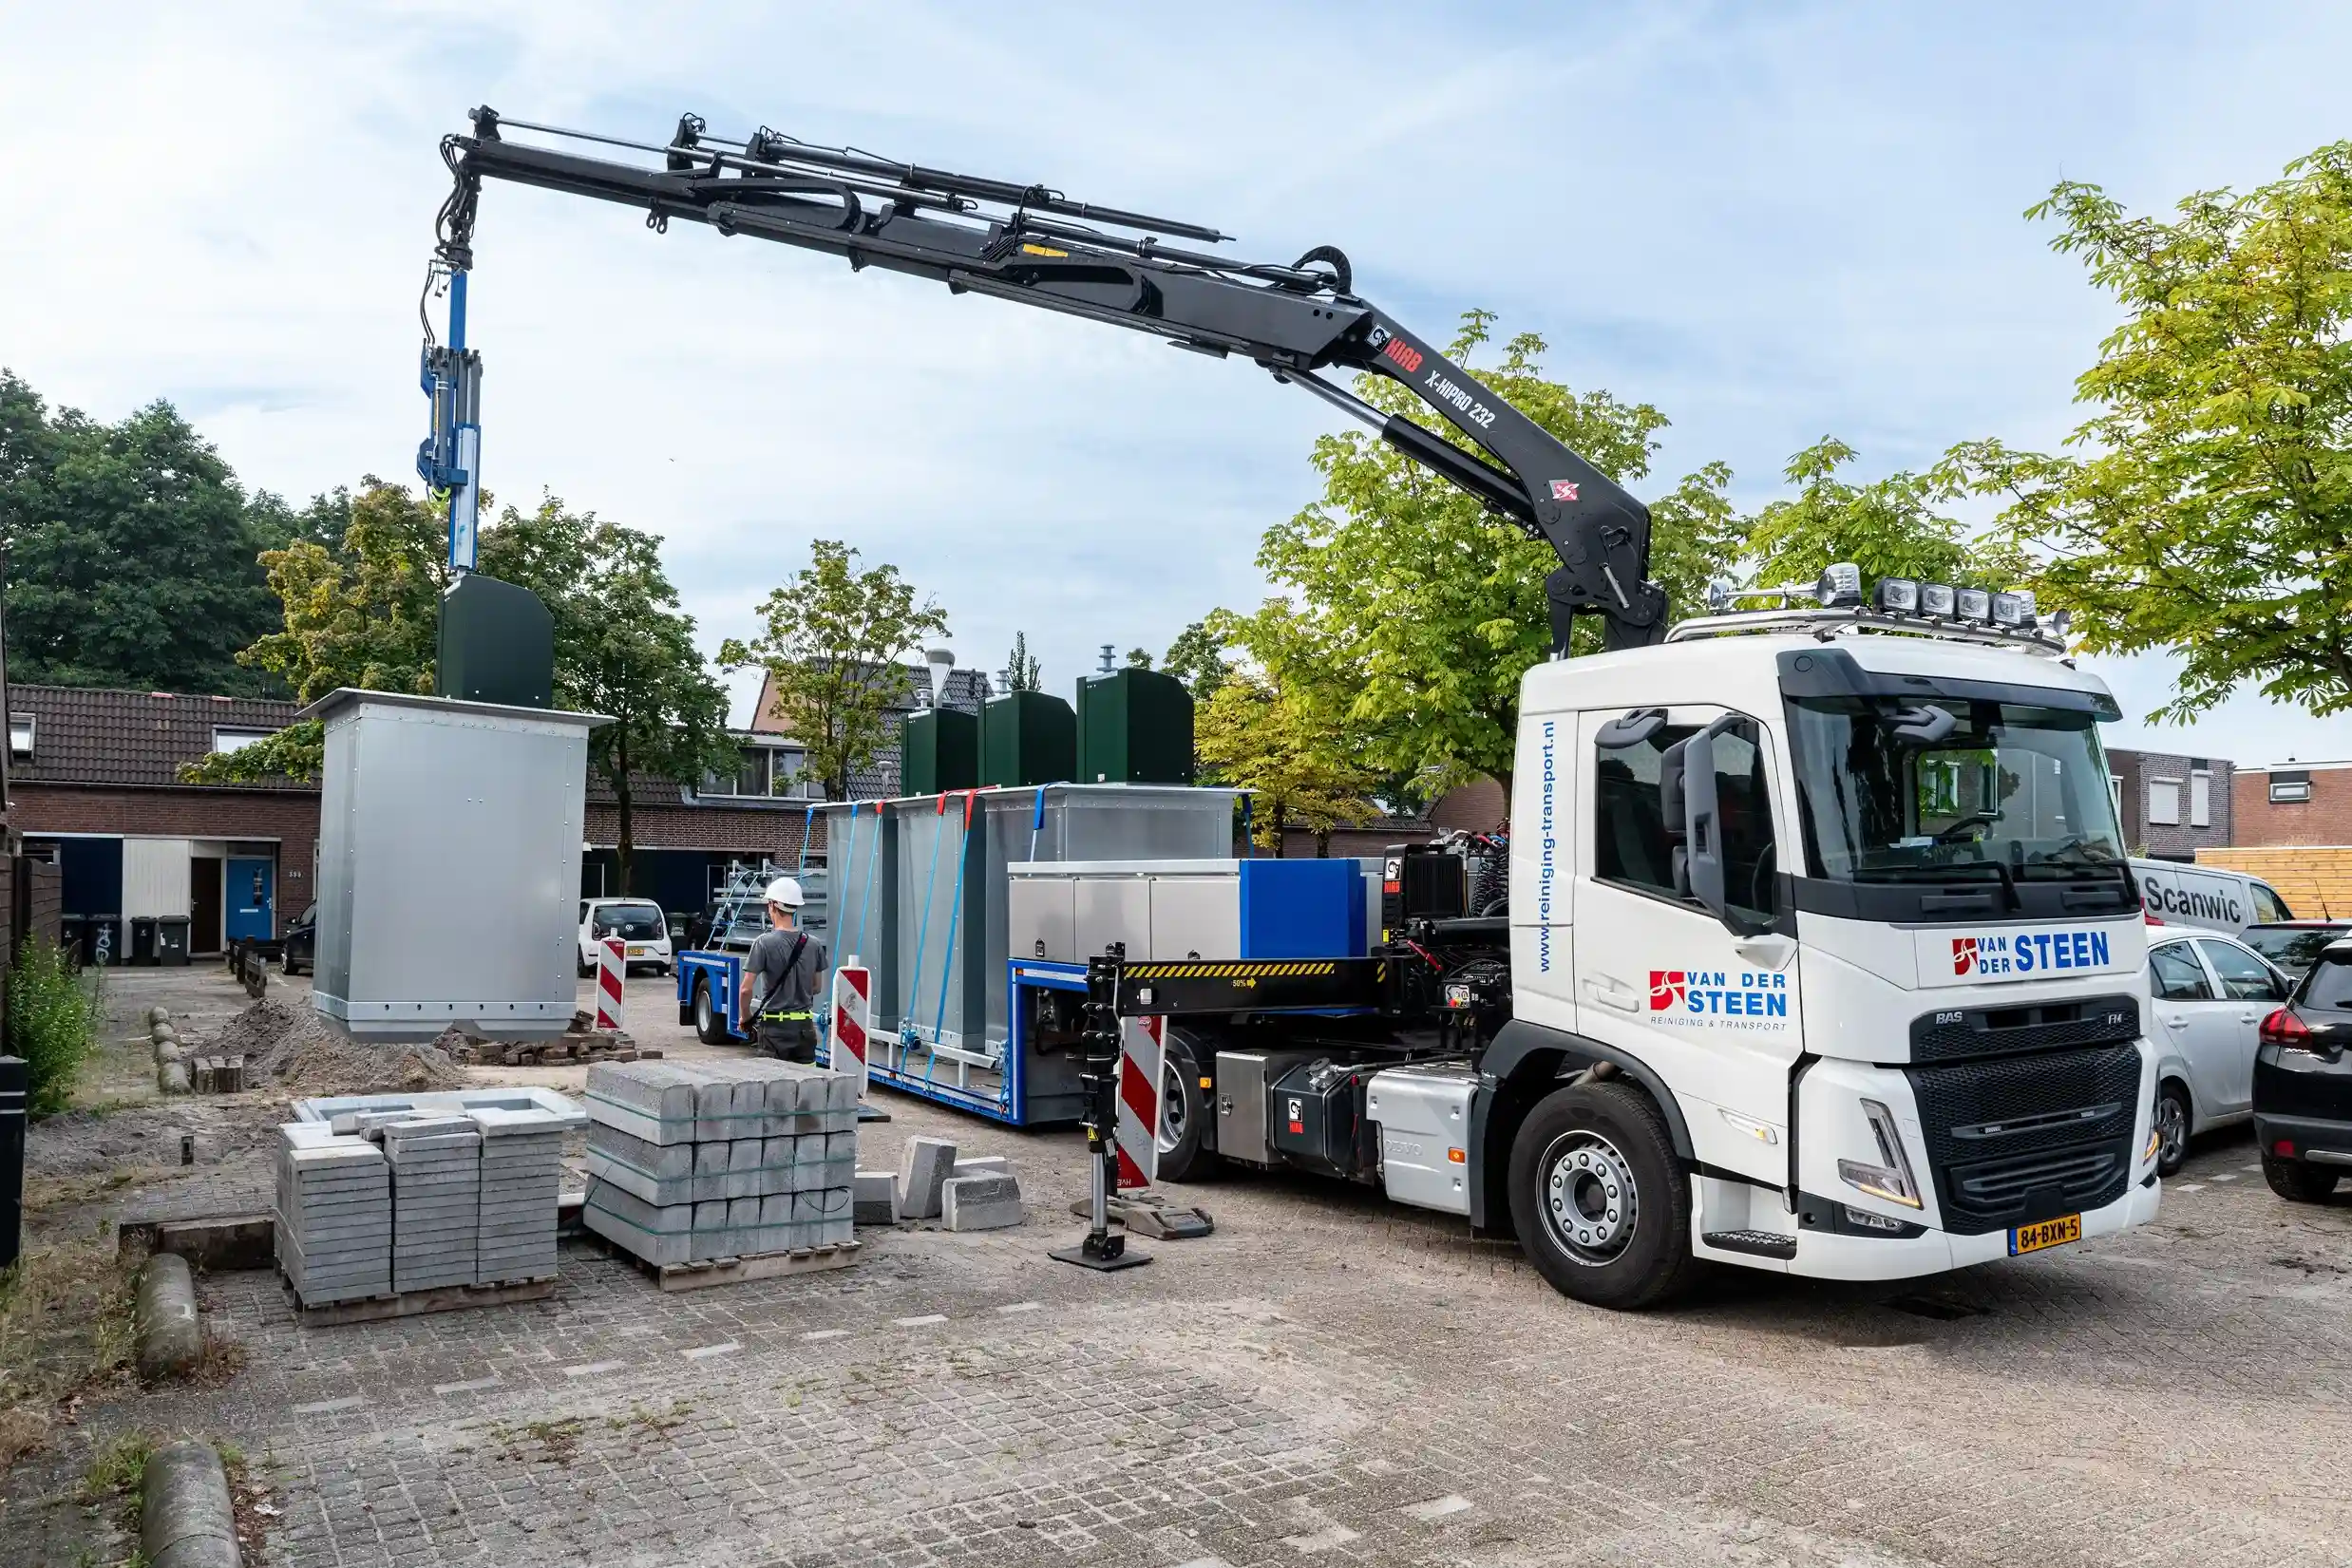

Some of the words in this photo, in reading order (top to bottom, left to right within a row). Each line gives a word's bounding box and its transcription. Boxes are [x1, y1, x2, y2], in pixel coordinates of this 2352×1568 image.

[1383, 337, 1423, 372] HIAB
[1425, 369, 1472, 411] X-HIPRO
[1468, 403, 1496, 428] 232
[1538, 721, 1556, 973] www.reiniging-transport.nl
[1383, 881, 1401, 894] HIAB
[2144, 876, 2242, 923] Scanwic
[1977, 936, 2007, 953] VAN
[2014, 931, 2110, 972] STEEN
[1979, 957, 2011, 974] DER
[1687, 972, 1726, 987] VAN
[1741, 973, 1786, 988] DER
[1687, 990, 1787, 1017] STEEN
[1650, 1016, 1704, 1028] REINIGING
[1708, 1019, 1715, 1028] &
[1720, 1020, 1788, 1031] TRANSPORT
[1935, 1011, 1963, 1025] BAS
[2020, 1219, 2078, 1249] 84-BXN-5
